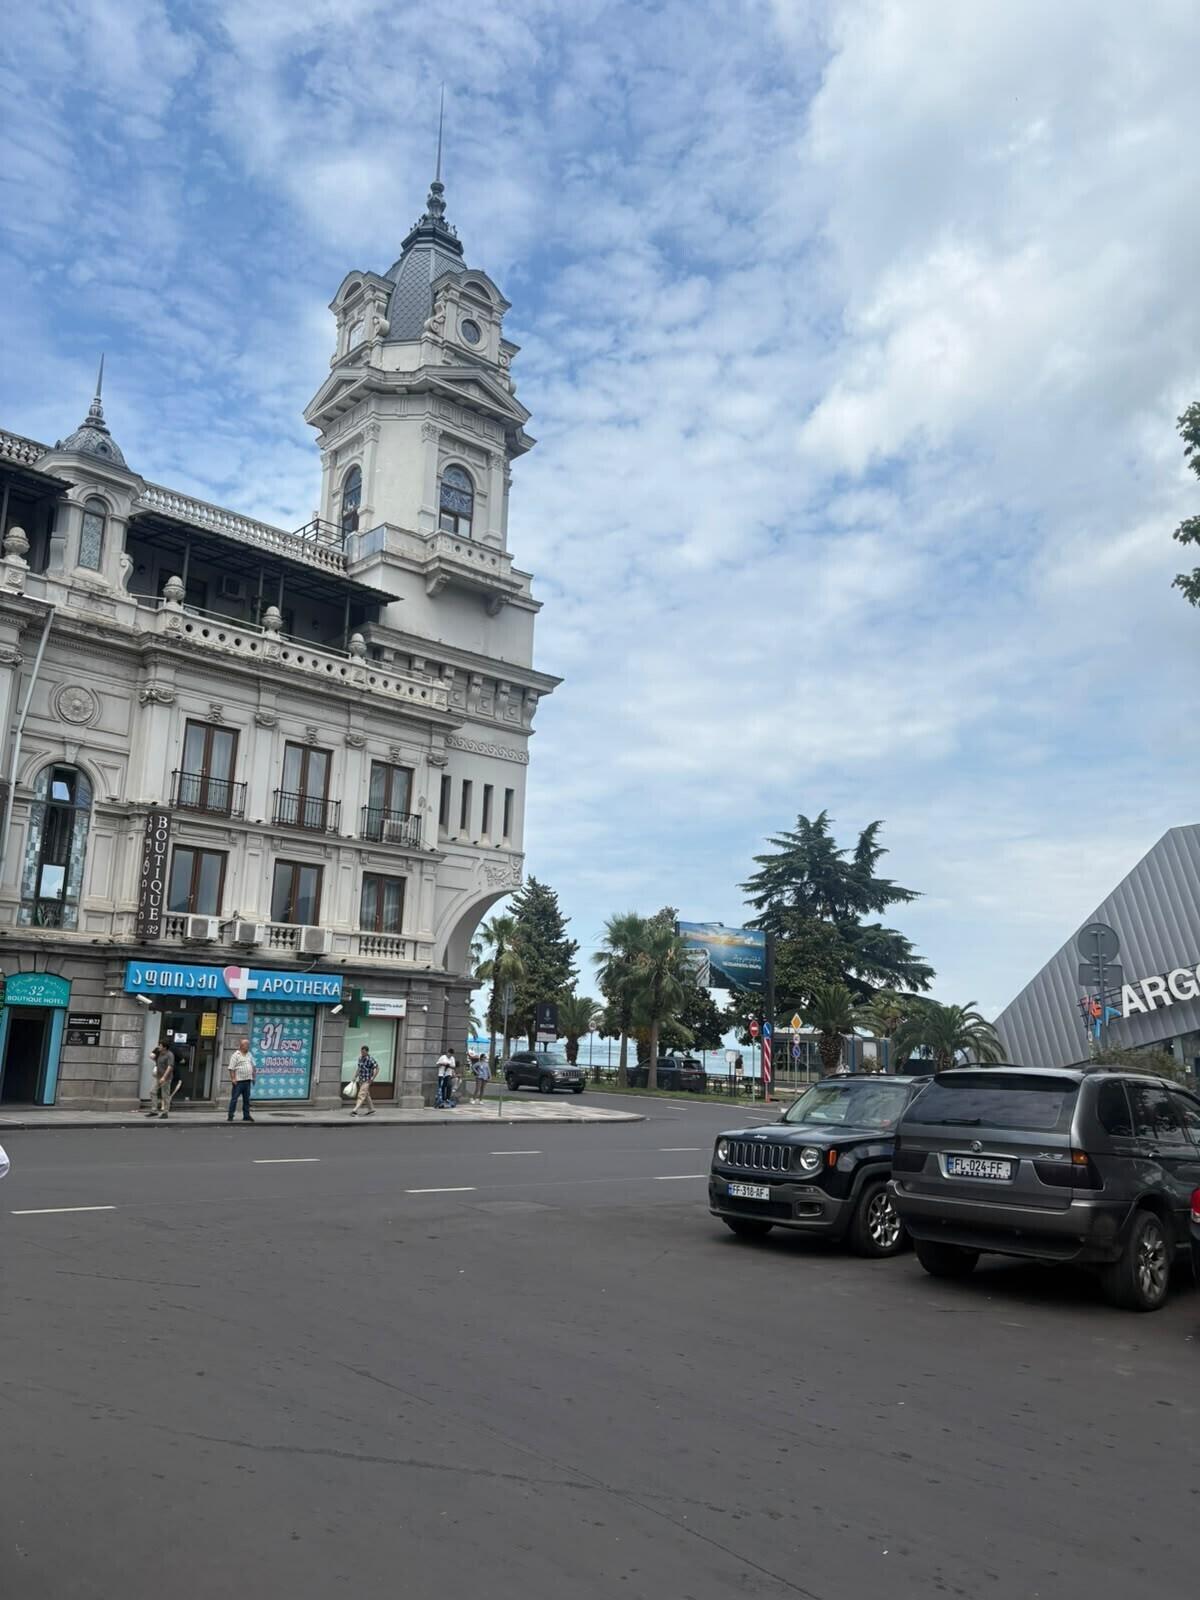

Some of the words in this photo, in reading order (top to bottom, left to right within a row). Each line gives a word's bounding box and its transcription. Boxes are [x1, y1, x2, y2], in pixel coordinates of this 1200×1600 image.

[148, 815, 168, 921] BOUTIQUE
[146, 925, 159, 935] 32
[132, 969, 218, 989] აფთიაქი
[262, 977, 340, 996] APOTHEKA
[7, 995, 43, 1003] BOUTIQUE
[28, 985, 45, 996] 32
[1121, 964, 1200, 1018] ARG
[260, 1023, 283, 1050] 31
[954, 1158, 1003, 1174] FL-024-FF
